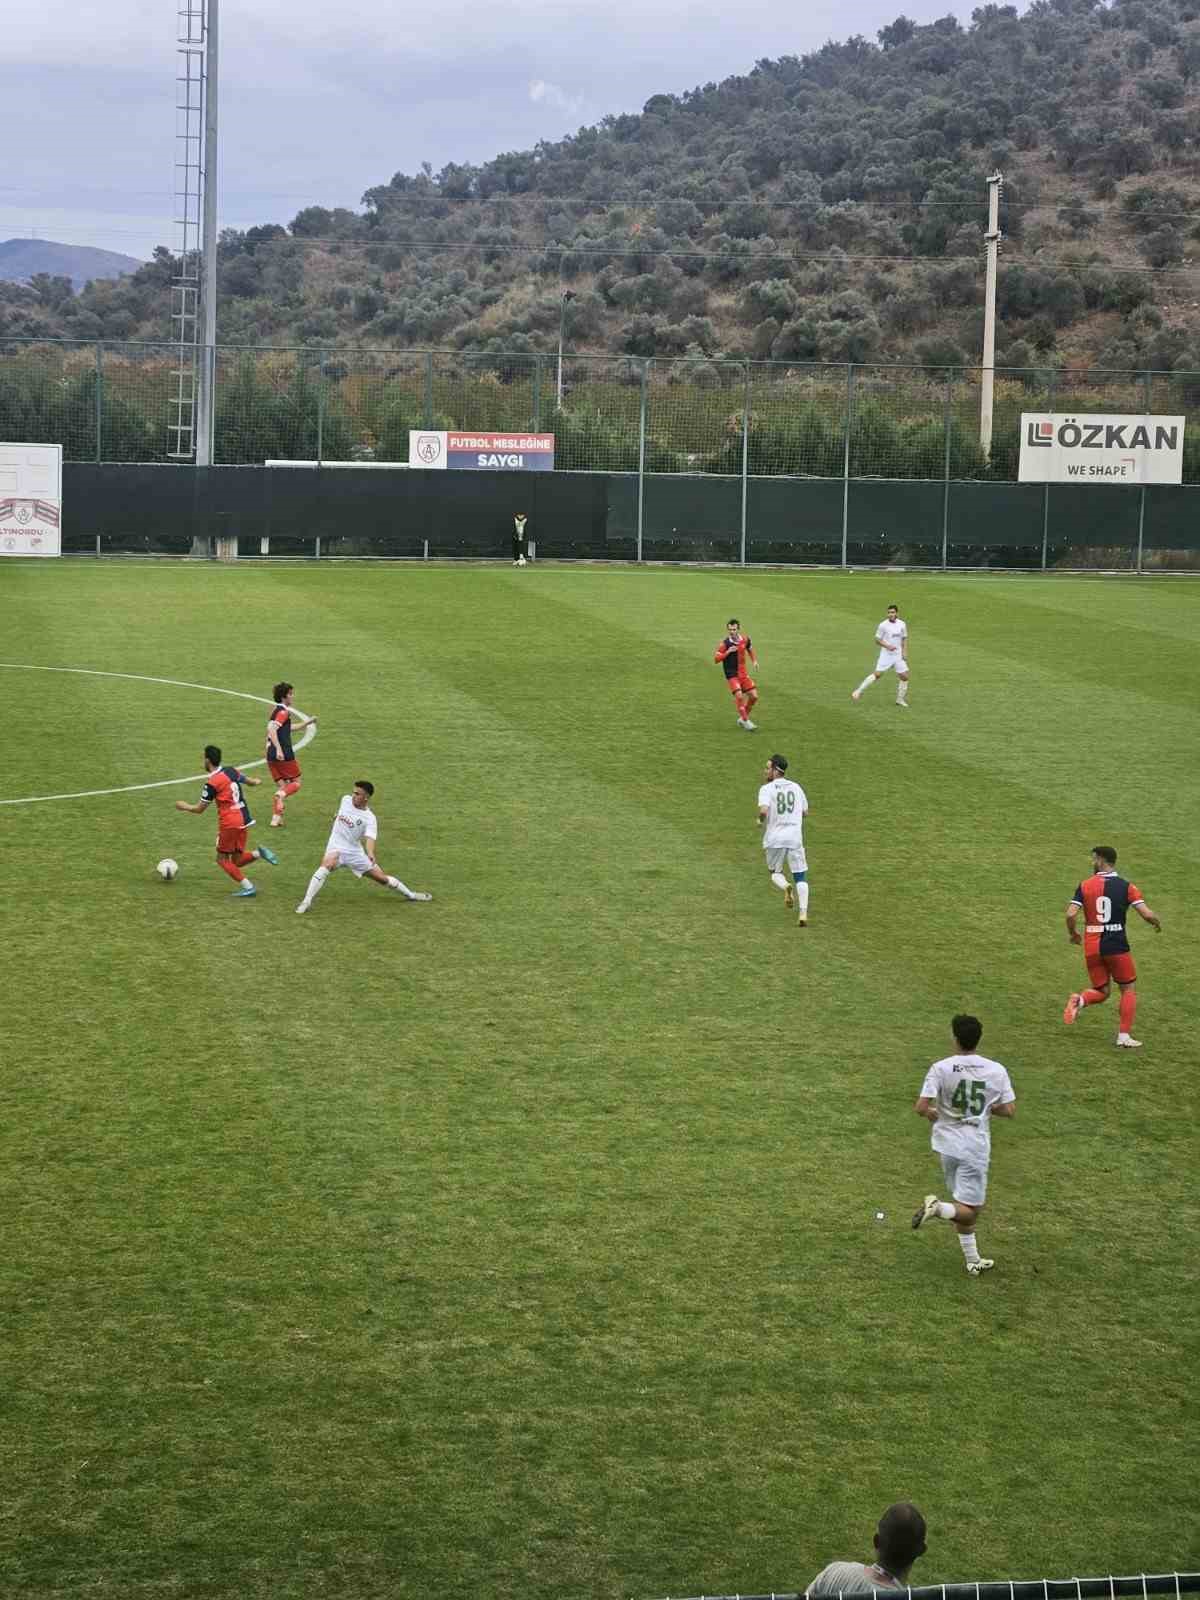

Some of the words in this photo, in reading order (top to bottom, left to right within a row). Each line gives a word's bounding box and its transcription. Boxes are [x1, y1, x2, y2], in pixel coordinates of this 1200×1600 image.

[450, 437, 490, 448] FUTBOL
[1057, 418, 1178, 450] ÖZKAN
[477, 454, 523, 467] SAYGI
[1067, 465, 1086, 476] WE
[1088, 465, 1127, 476] SHAPE
[776, 790, 795, 815] 89
[1096, 896, 1112, 923] 9
[951, 1079, 987, 1117] 45
